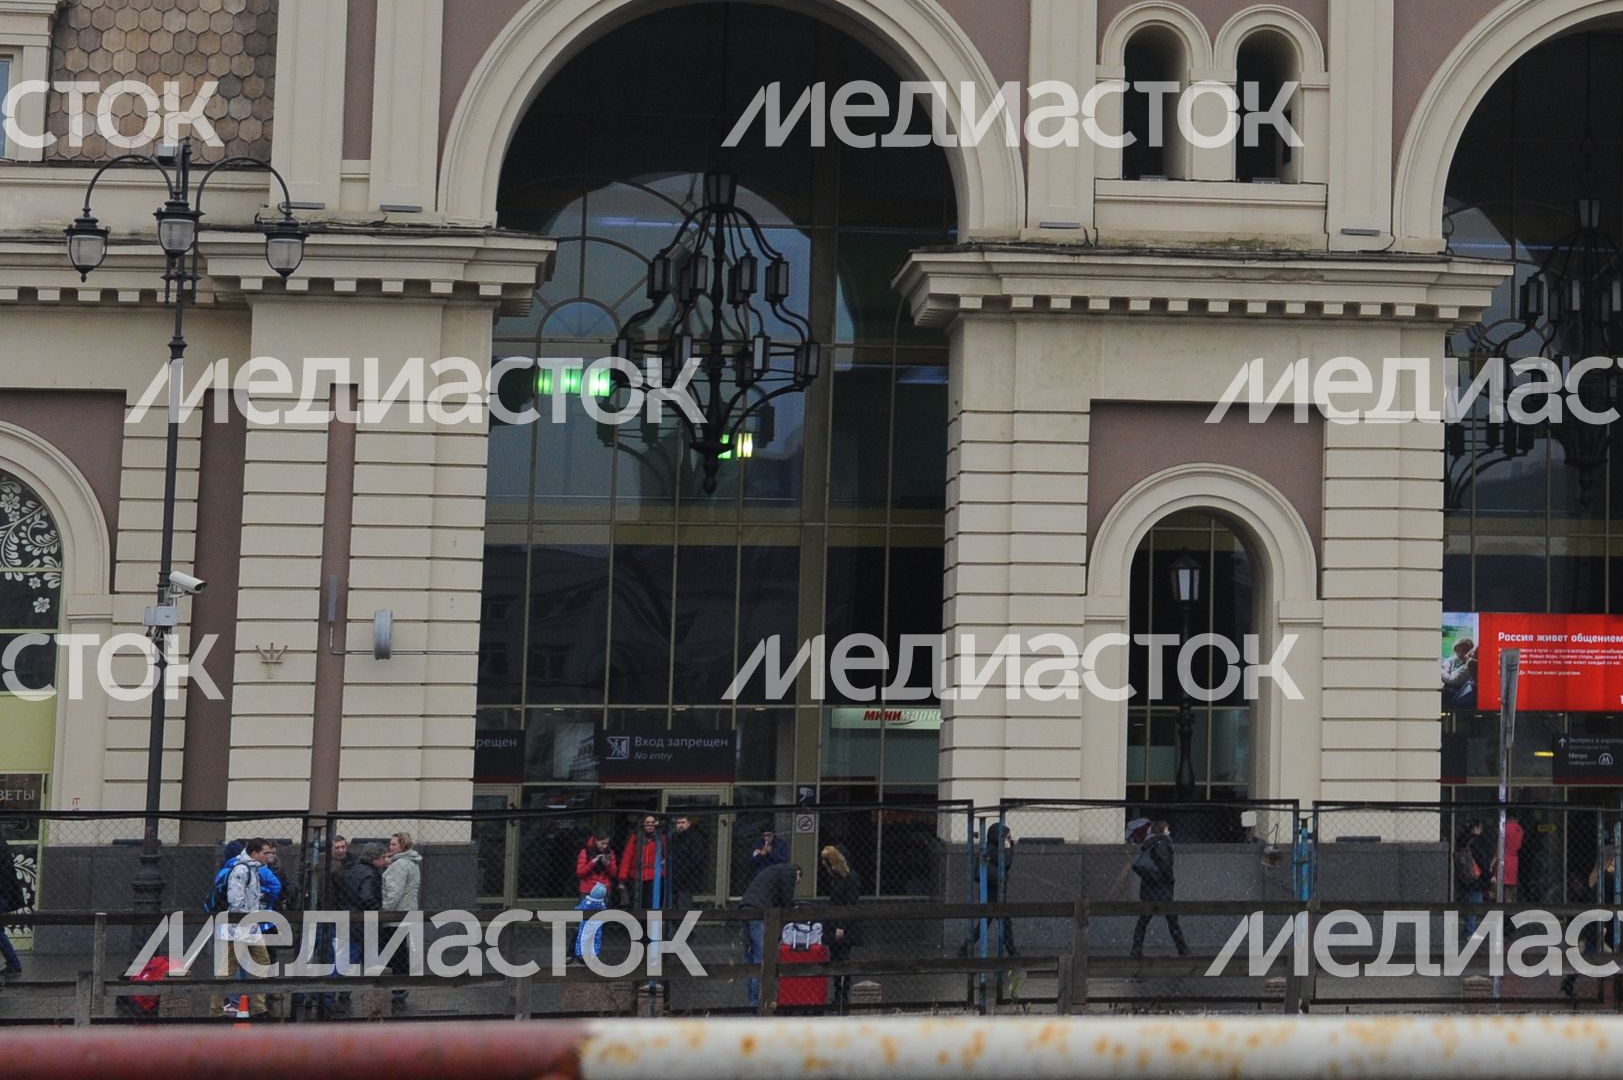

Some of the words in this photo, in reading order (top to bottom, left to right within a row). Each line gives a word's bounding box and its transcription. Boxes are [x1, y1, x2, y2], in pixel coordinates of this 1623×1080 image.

[1498, 631, 1534, 642] Россия
[1536, 634, 1568, 642] живет
[1571, 633, 1623, 644] общением
[634, 736, 665, 749] Вход
[667, 738, 729, 750] запрещен
[634, 753, 646, 761] No
[648, 753, 673, 762] entry
